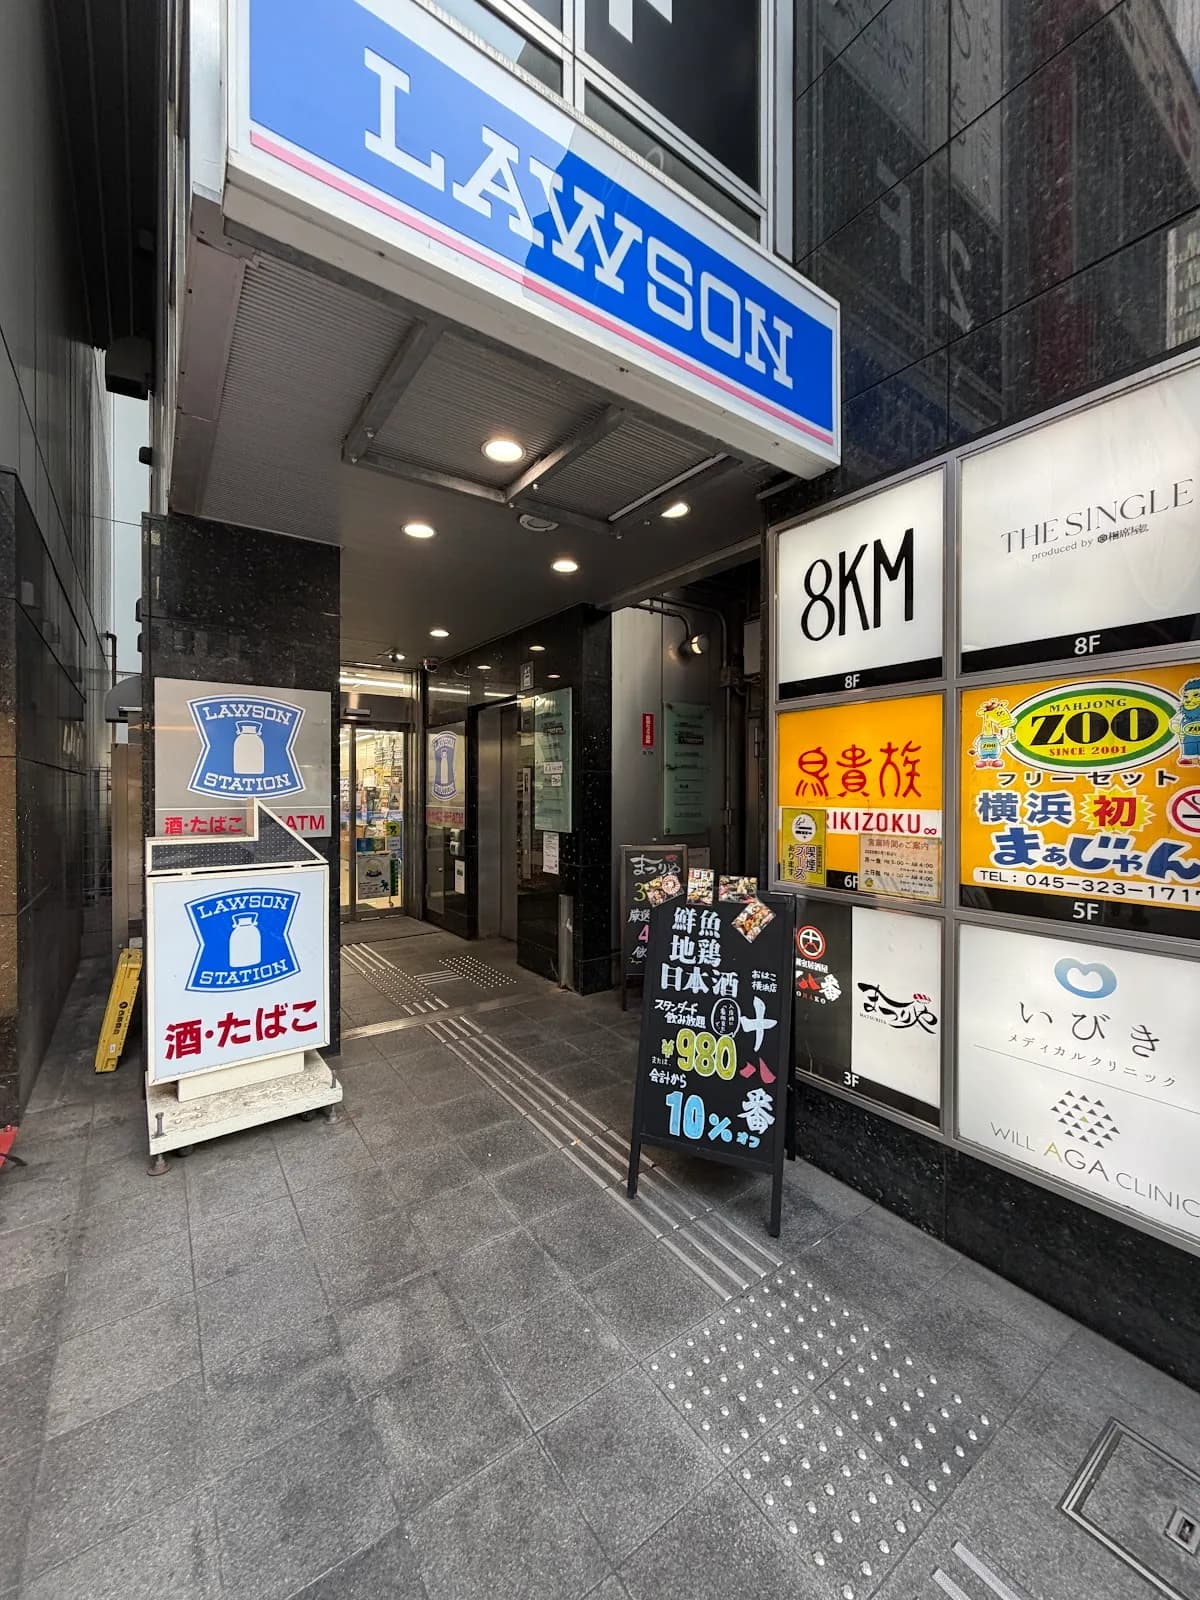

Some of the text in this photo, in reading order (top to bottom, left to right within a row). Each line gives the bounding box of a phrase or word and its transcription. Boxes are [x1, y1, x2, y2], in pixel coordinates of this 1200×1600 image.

[364, 46, 794, 390] LAWSON
[1001, 478, 1193, 554] THE SINGLE
[1031, 542, 1077, 562] produced
[1081, 538, 1094, 553] by
[801, 528, 914, 642] 8KM
[1074, 634, 1101, 655] 8F
[844, 674, 861, 689] 8F
[203, 703, 292, 725] LAWSON
[1049, 698, 1127, 712] MAHJONG
[1031, 707, 1159, 746] ZOO
[1049, 745, 1127, 756] SINCE 2001
[203, 772, 292, 792] STATION
[795, 740, 922, 798] 鳥貴族
[998, 770, 1178, 786] フリーセット
[978, 792, 1137, 827] 横浜 初
[164, 816, 243, 834] 酒・たばこ
[630, 854, 681, 876] まつりや
[993, 827, 1200, 880] まぁじゃん
[197, 896, 289, 919] LAWSON
[1073, 902, 1099, 920] 5F
[671, 907, 721, 939] 鮮魚
[669, 935, 721, 967] 地鶏
[199, 959, 289, 985] STATION
[660, 963, 740, 998] 日本酒
[752, 969, 777, 981] おはこ
[796, 970, 842, 1001] 八番
[664, 1011, 706, 1029] 飲み放題
[857, 984, 938, 1034] まつりや
[165, 1000, 318, 1060] 酒・たばこ
[1017, 1001, 1160, 1058] いびき
[1008, 1033, 1176, 1088] メディカルクリニック
[649, 1068, 687, 1088] 会計から
[843, 1071, 860, 1088] 3F
[990, 1121, 1200, 1218] WILL AGA CLINIC
